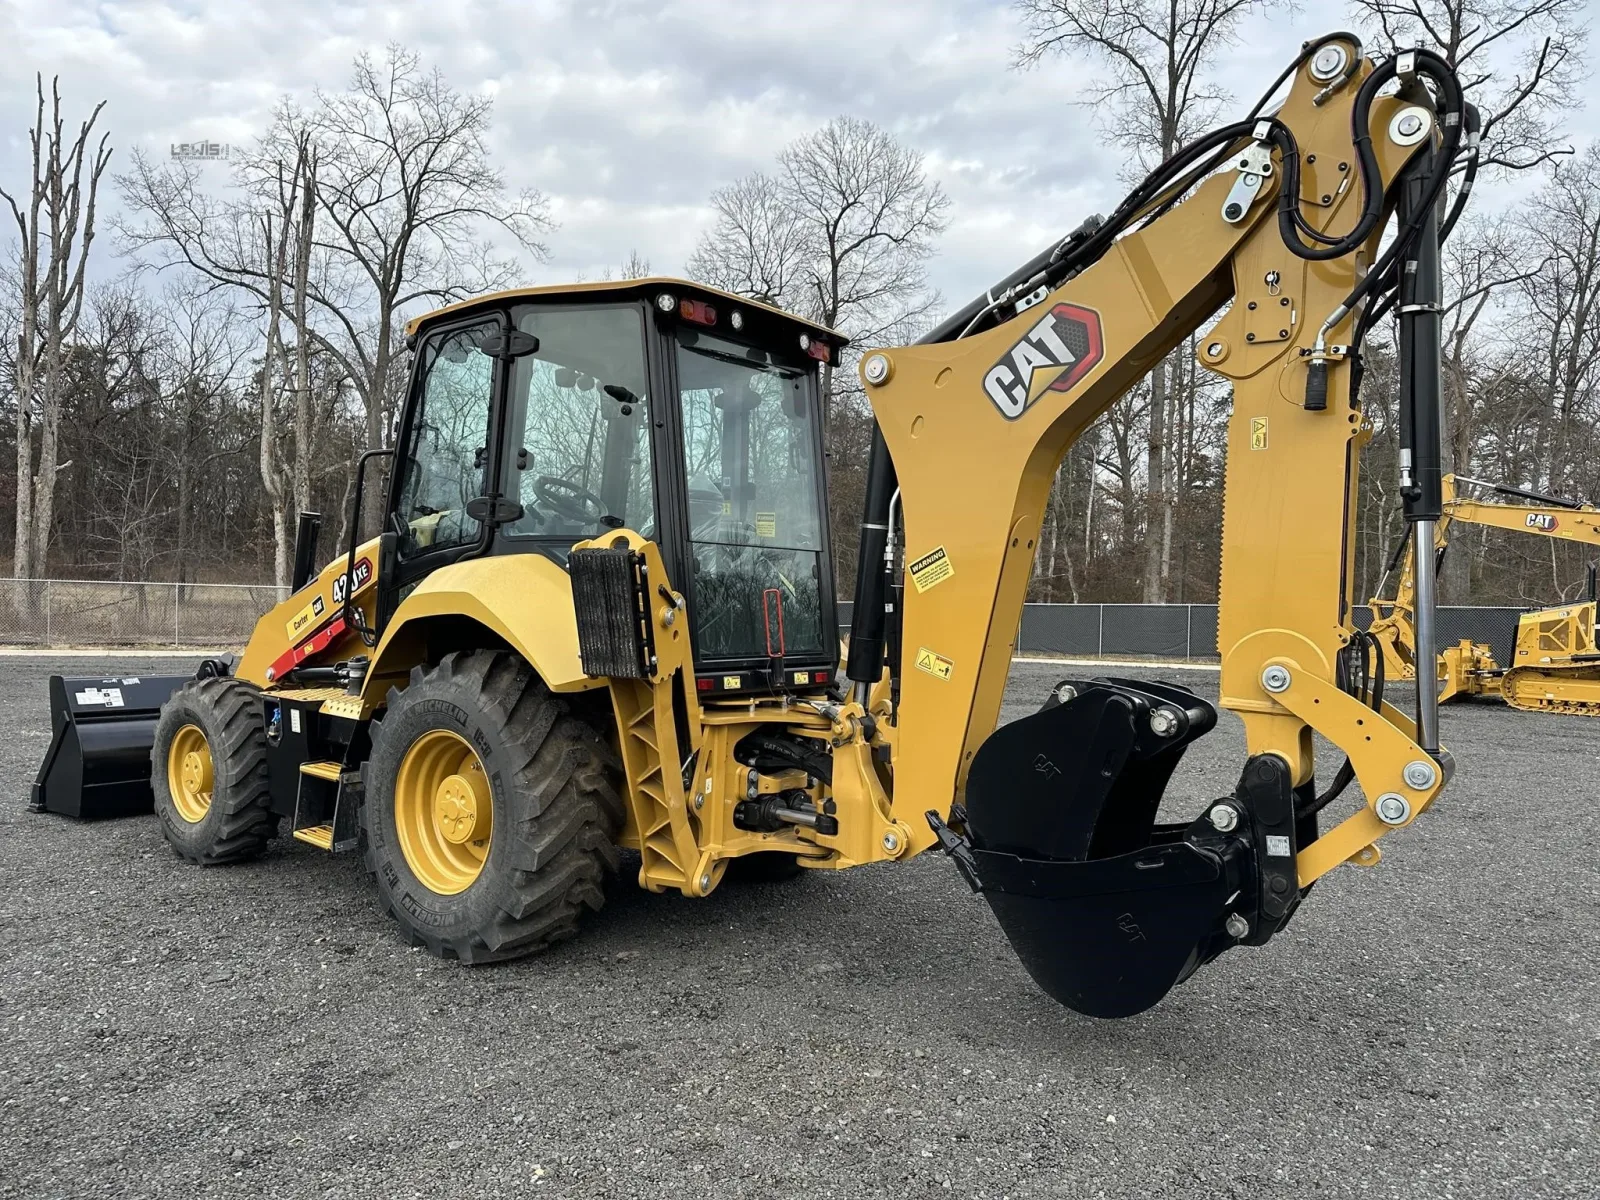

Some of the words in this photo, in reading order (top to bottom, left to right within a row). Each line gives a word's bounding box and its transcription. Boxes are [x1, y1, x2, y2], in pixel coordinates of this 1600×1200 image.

[984, 313, 1076, 418] CAT
[1526, 513, 1553, 529] CAT
[911, 550, 944, 573] WARNING
[293, 614, 309, 631] Carter
[414, 699, 468, 723] MICHELIN
[402, 896, 456, 927] MICHELIN
